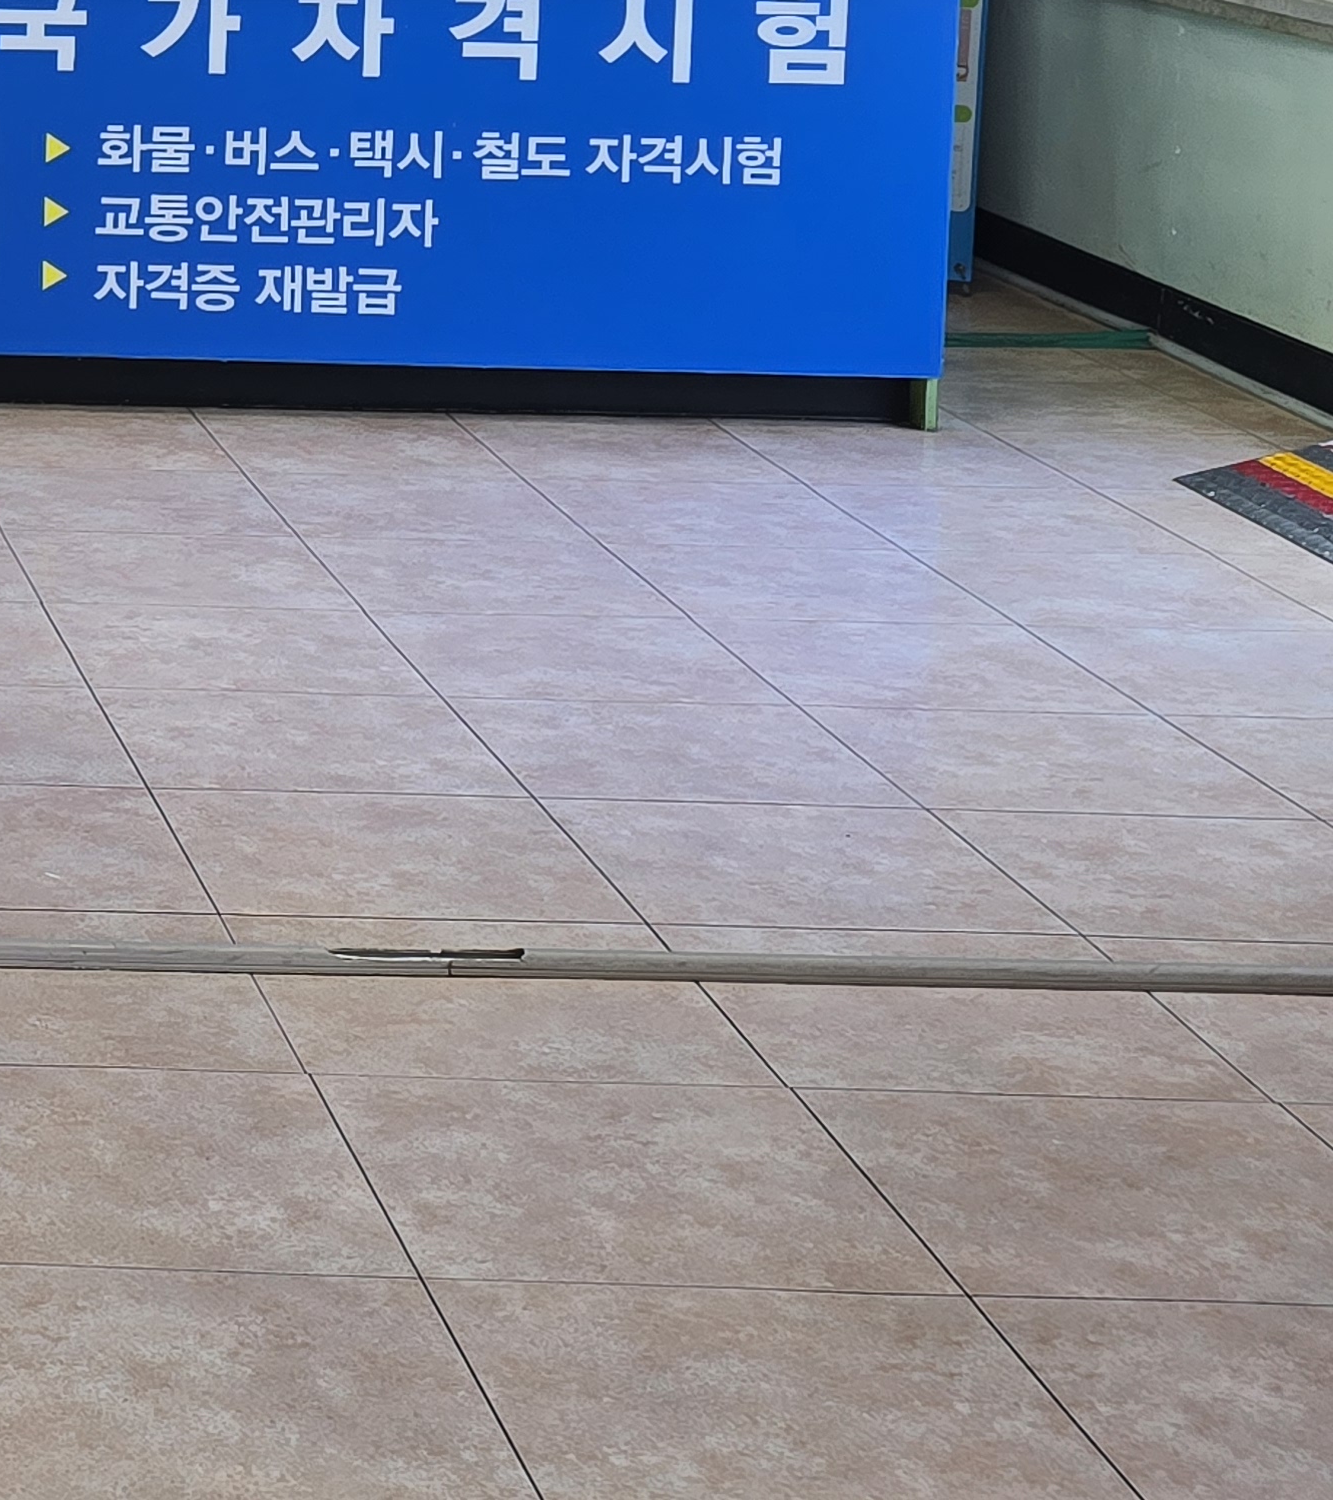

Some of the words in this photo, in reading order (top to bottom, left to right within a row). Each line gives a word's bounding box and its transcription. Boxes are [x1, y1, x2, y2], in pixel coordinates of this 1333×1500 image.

[586, 133, 783, 187] 자격시험
[94, 194, 439, 248] 교통안전관리자
[93, 261, 240, 313] 자격증
[255, 263, 403, 316] 재발급
